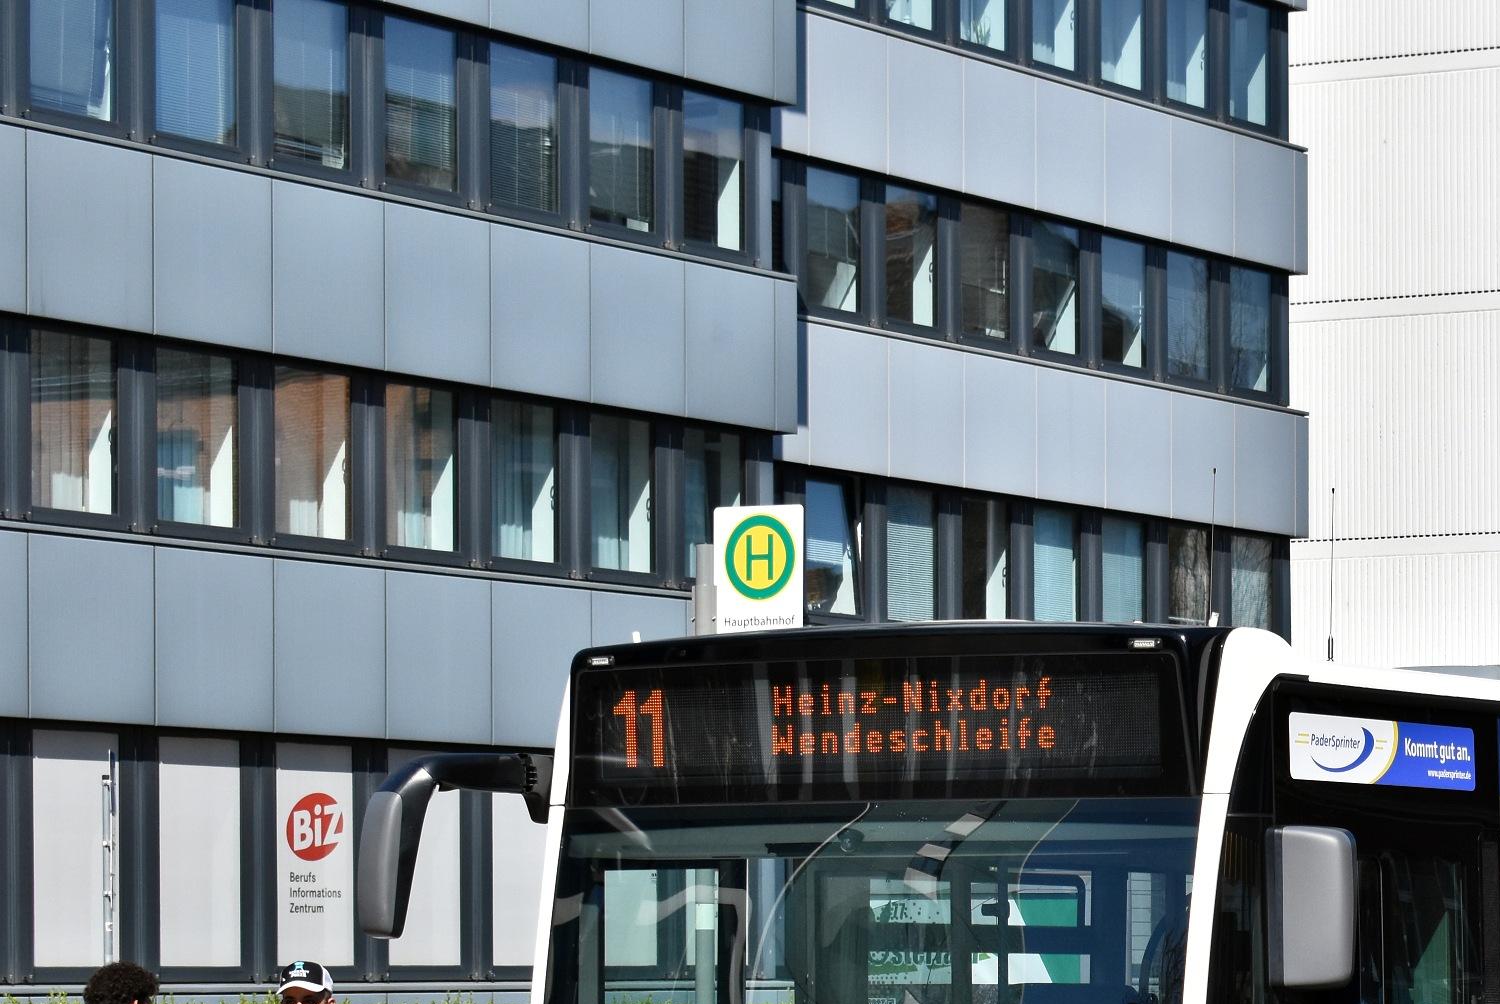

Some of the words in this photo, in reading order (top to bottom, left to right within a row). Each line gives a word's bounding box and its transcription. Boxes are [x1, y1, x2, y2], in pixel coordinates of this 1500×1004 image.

[746, 534, 774, 581] H
[724, 615, 796, 628] Hauptbahnhof
[773, 677, 1051, 717] Heinz-Nixdorf
[613, 690, 664, 768] 11
[771, 717, 1056, 755] Wendeschleife
[1310, 733, 1361, 751] PaderSprinter
[1404, 737, 1438, 759] Kommt
[1439, 742, 1456, 764] gut
[1456, 746, 1471, 762] an.
[1427, 769, 1472, 781] www.padersprinter.de
[293, 803, 343, 852] BiZ
[289, 871, 317, 883] Berufs
[289, 886, 342, 898] Informations
[289, 902, 324, 913] Zentrum
